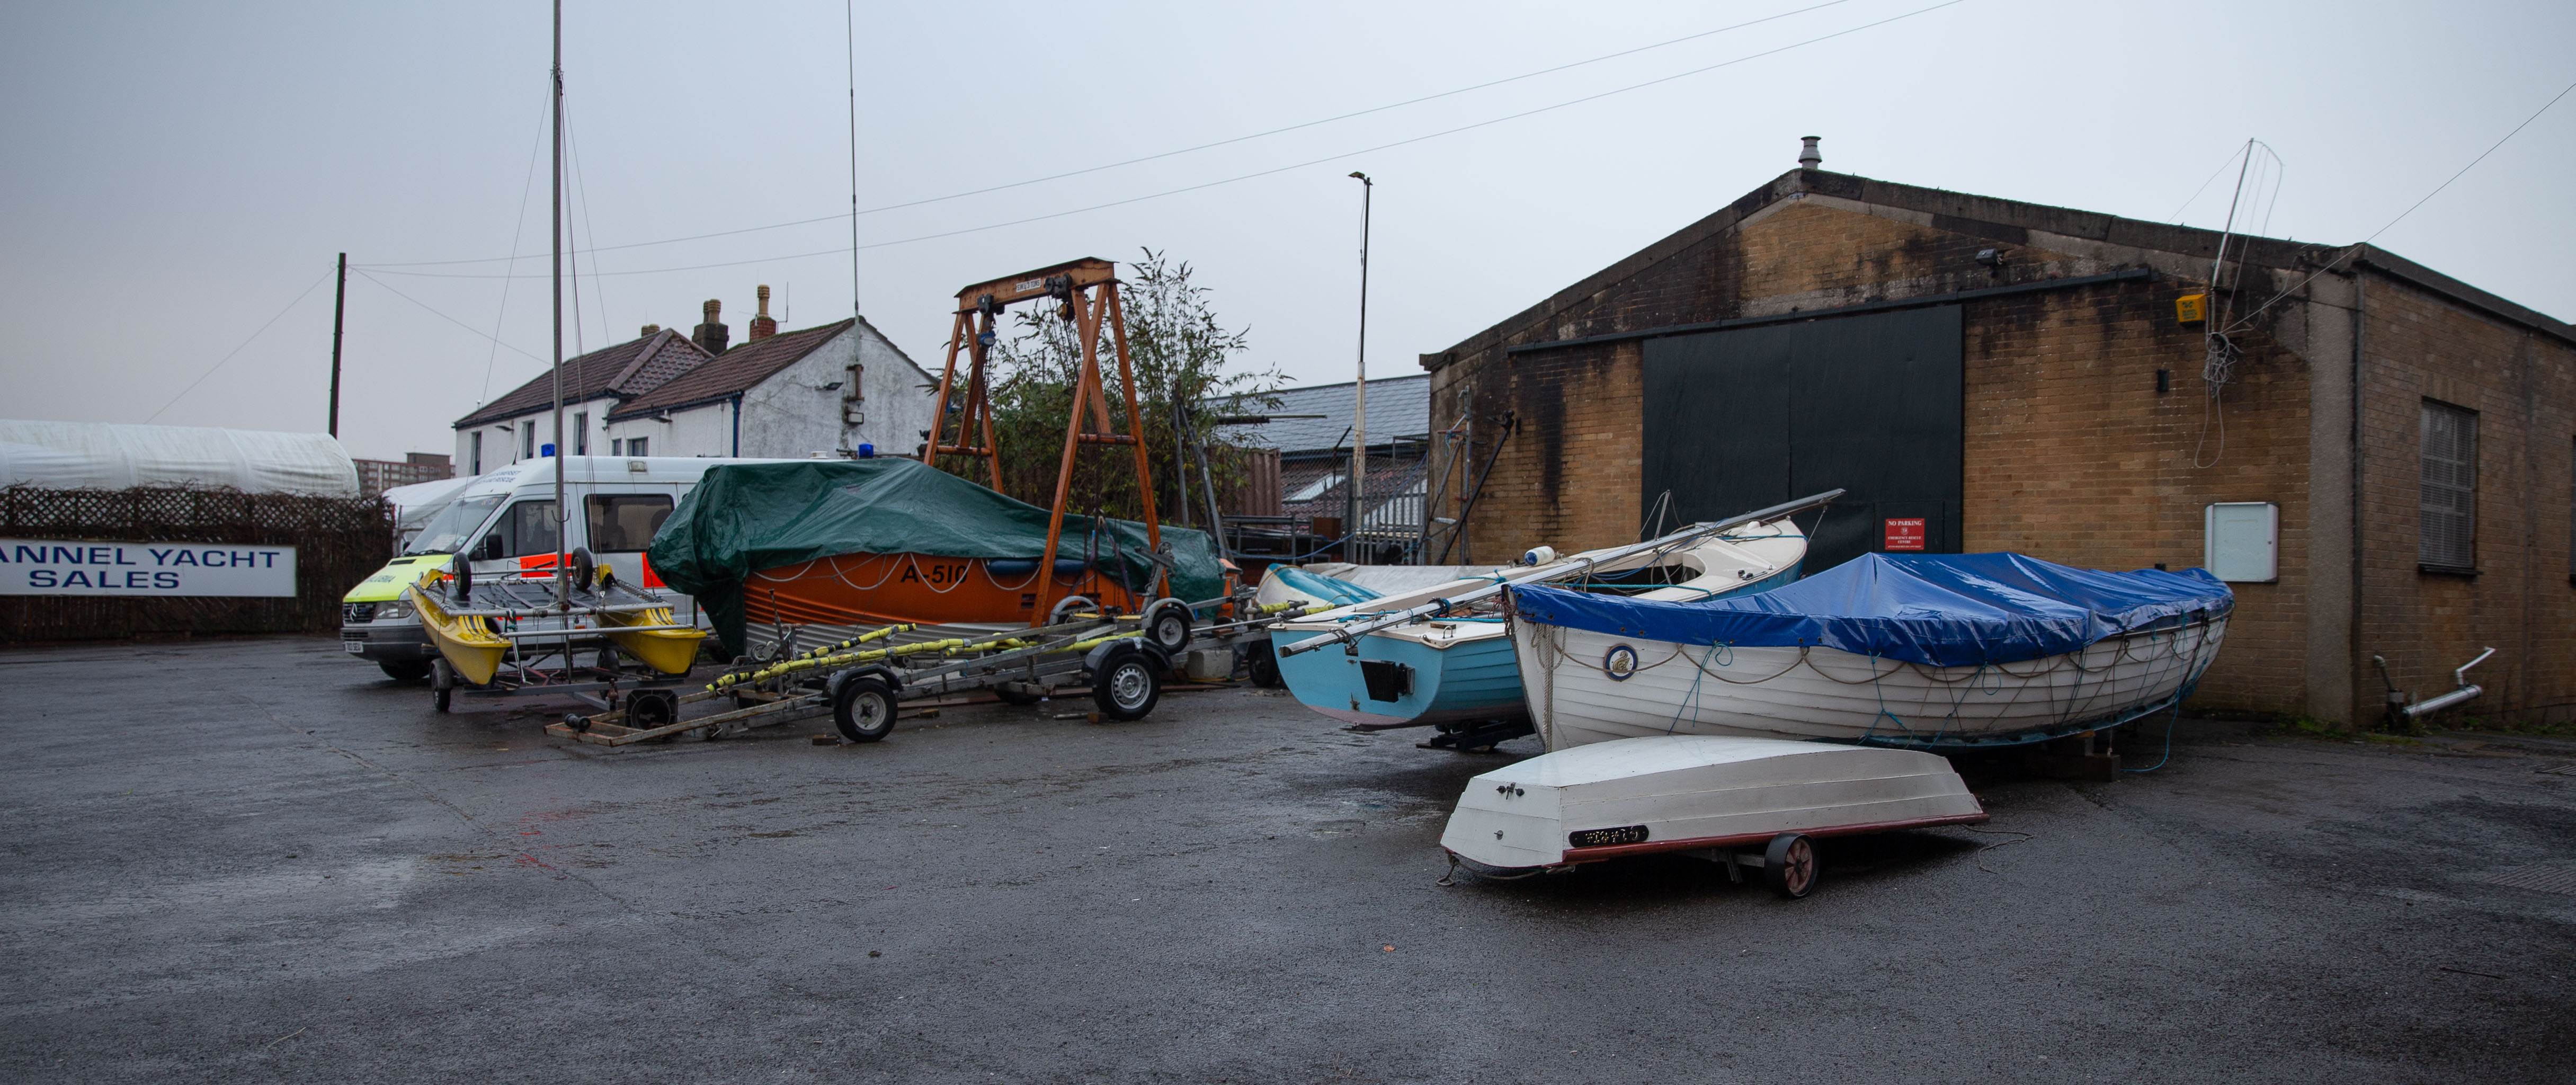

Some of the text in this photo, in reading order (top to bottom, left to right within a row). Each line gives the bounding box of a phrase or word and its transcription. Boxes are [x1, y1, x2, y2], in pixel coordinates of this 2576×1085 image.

[148, 548, 280, 567] YACHT
[29, 570, 179, 588] SALES
[900, 564, 968, 583] A-510
